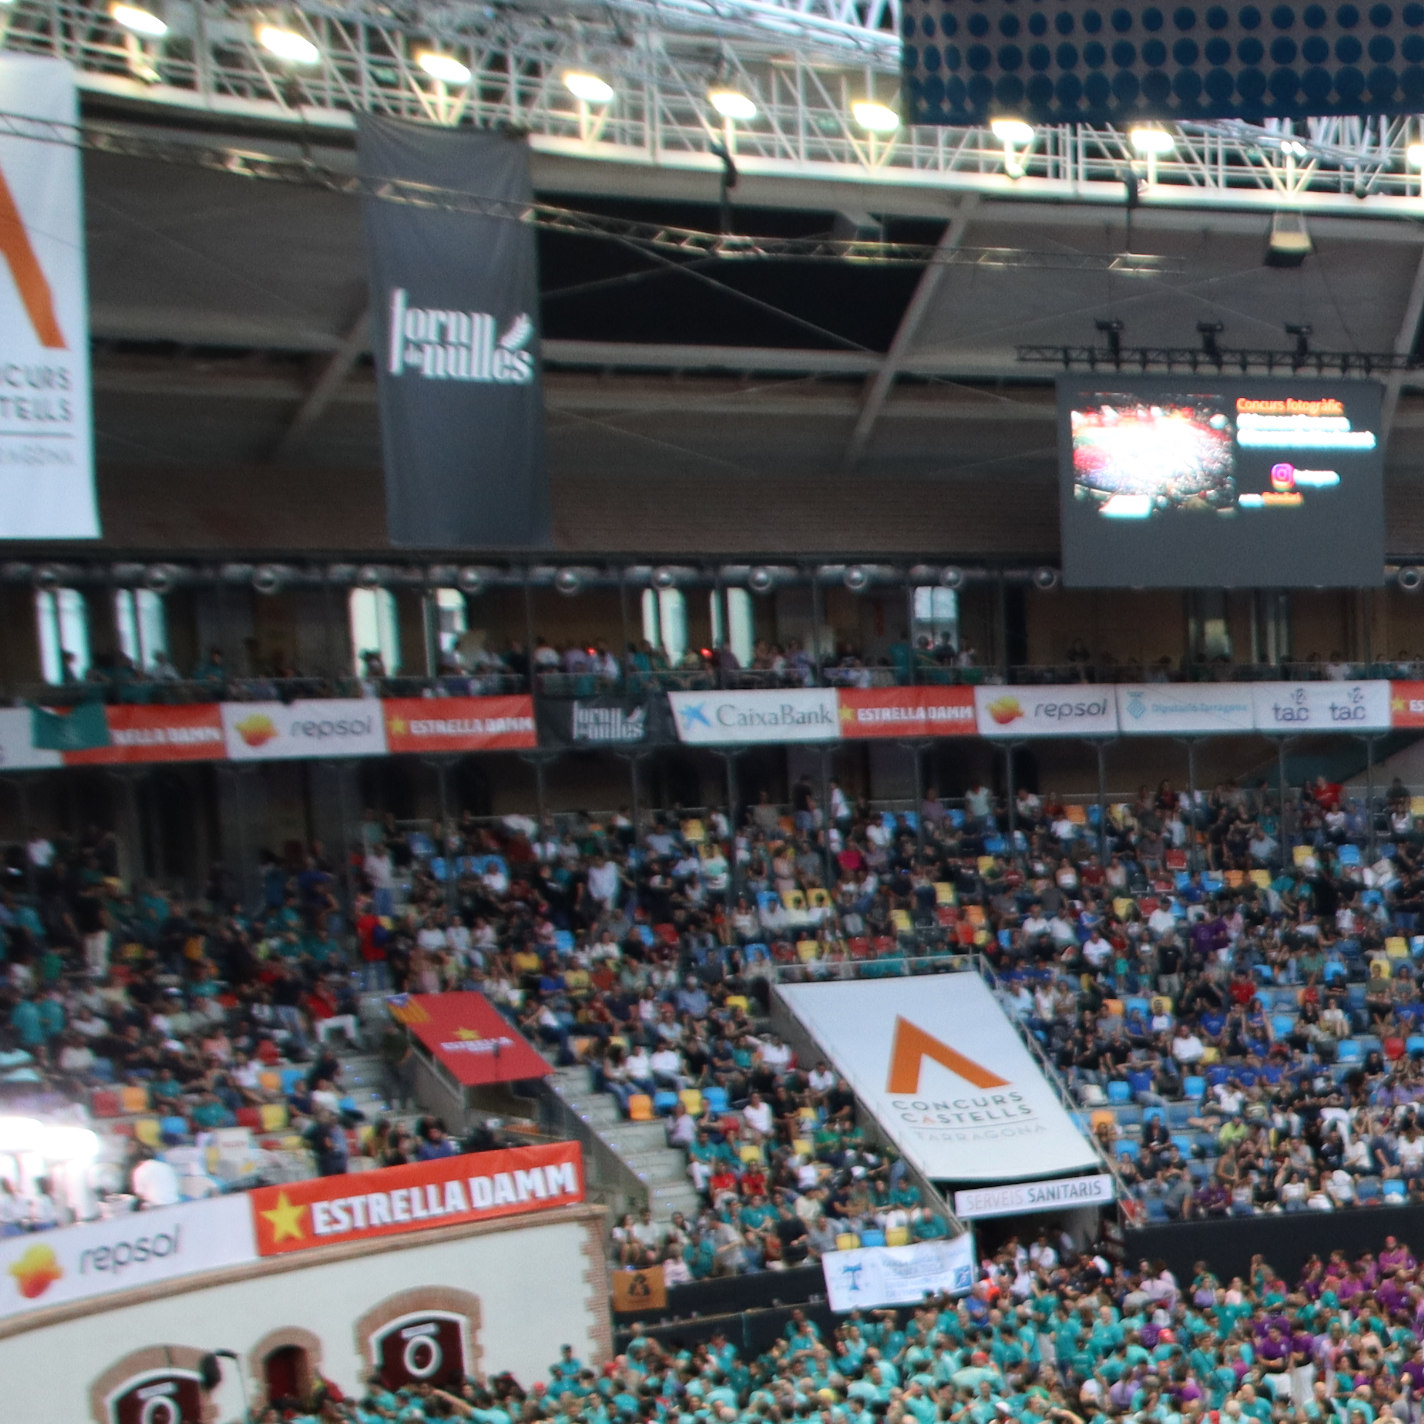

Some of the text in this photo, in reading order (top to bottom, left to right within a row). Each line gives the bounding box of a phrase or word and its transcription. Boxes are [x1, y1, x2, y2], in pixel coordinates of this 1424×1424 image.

[1236, 398, 1286, 413] Concurs
[716, 703, 833, 727] CaixaBank
[857, 705, 973, 722] ESTRELLA DAMM
[1034, 699, 1107, 720] repsol
[291, 716, 373, 738] repsol
[409, 717, 533, 735] ESTRELLA DAMM
[891, 1091, 1023, 1111] CONCURS
[900, 1104, 1033, 1124] CASTELLS
[914, 1124, 1048, 1141] TARRAGONA
[311, 1162, 577, 1236] ESTRELLA DAMM
[966, 1180, 1103, 1211] SERVEIS SANITARIS
[79, 1223, 181, 1275] repsol
